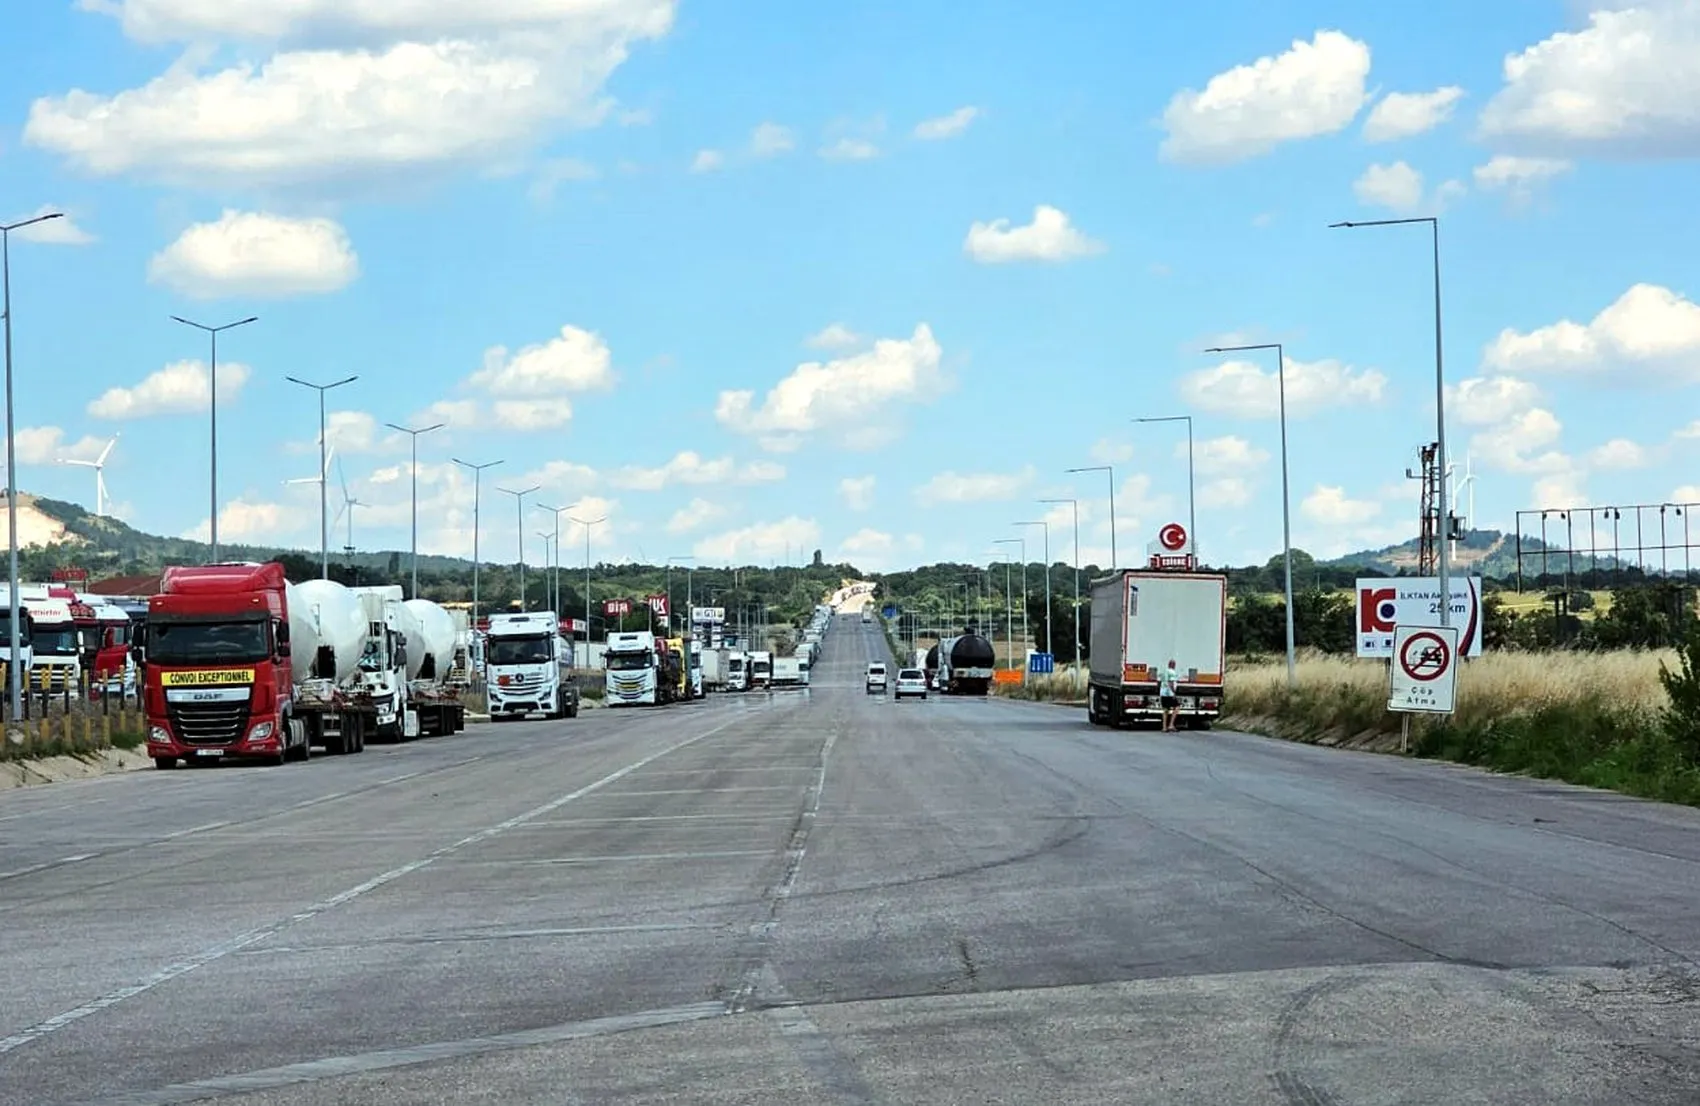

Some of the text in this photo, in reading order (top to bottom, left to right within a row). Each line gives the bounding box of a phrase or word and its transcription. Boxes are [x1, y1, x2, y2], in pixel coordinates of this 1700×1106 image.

[170, 670, 250, 684] CONVOI EXCEPTIONNEL
[1406, 695, 1437, 706] Atma
